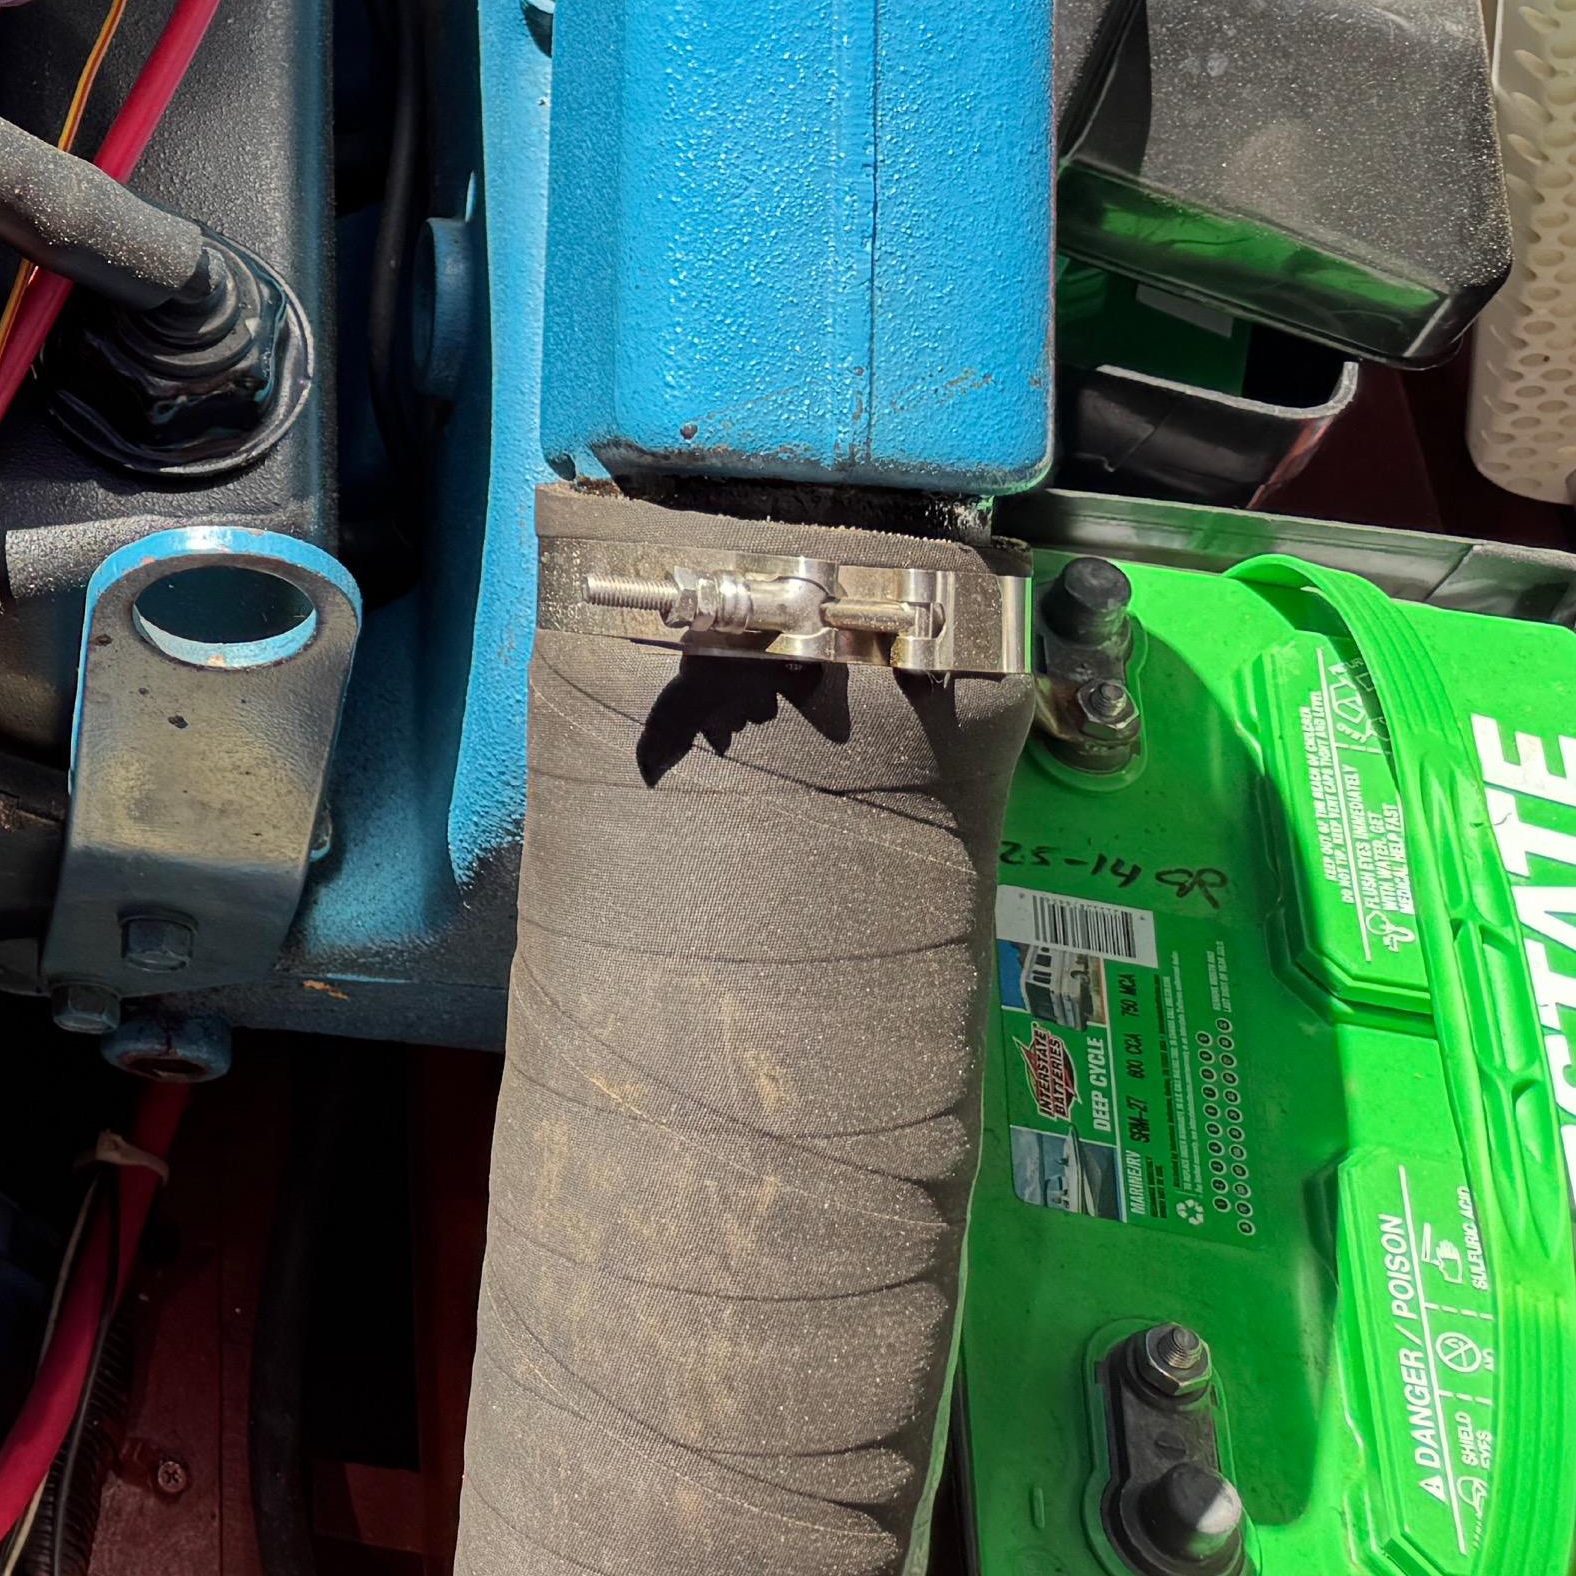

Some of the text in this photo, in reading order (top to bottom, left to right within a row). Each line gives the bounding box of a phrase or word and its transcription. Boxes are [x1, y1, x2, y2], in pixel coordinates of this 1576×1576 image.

[1341, 762, 1381, 909] FLUSH EYES IMMEDIATELY
[1366, 811, 1385, 833] GET
[1381, 802, 1414, 914] MEDICAL HELP FAST
[1337, 867, 1352, 888] NOT
[1341, 890, 1354, 903] DO
[1374, 878, 1397, 911] WITH
[1118, 975, 1137, 997] MCA
[1033, 1028, 1054, 1119] INTERSTATE
[1047, 1038, 1070, 1119] BATTERIES
[1125, 1033, 1143, 1060] CCA
[1086, 1036, 1112, 1132] DEEP CYCLE
[1126, 1150, 1146, 1215] MARINE/RV
[1378, 1213, 1416, 1319] POISON
[1456, 1185, 1489, 1291] SULFURIC ACID
[1400, 1346, 1442, 1470] DANGER
[1454, 1410, 1479, 1465] SHIELD
